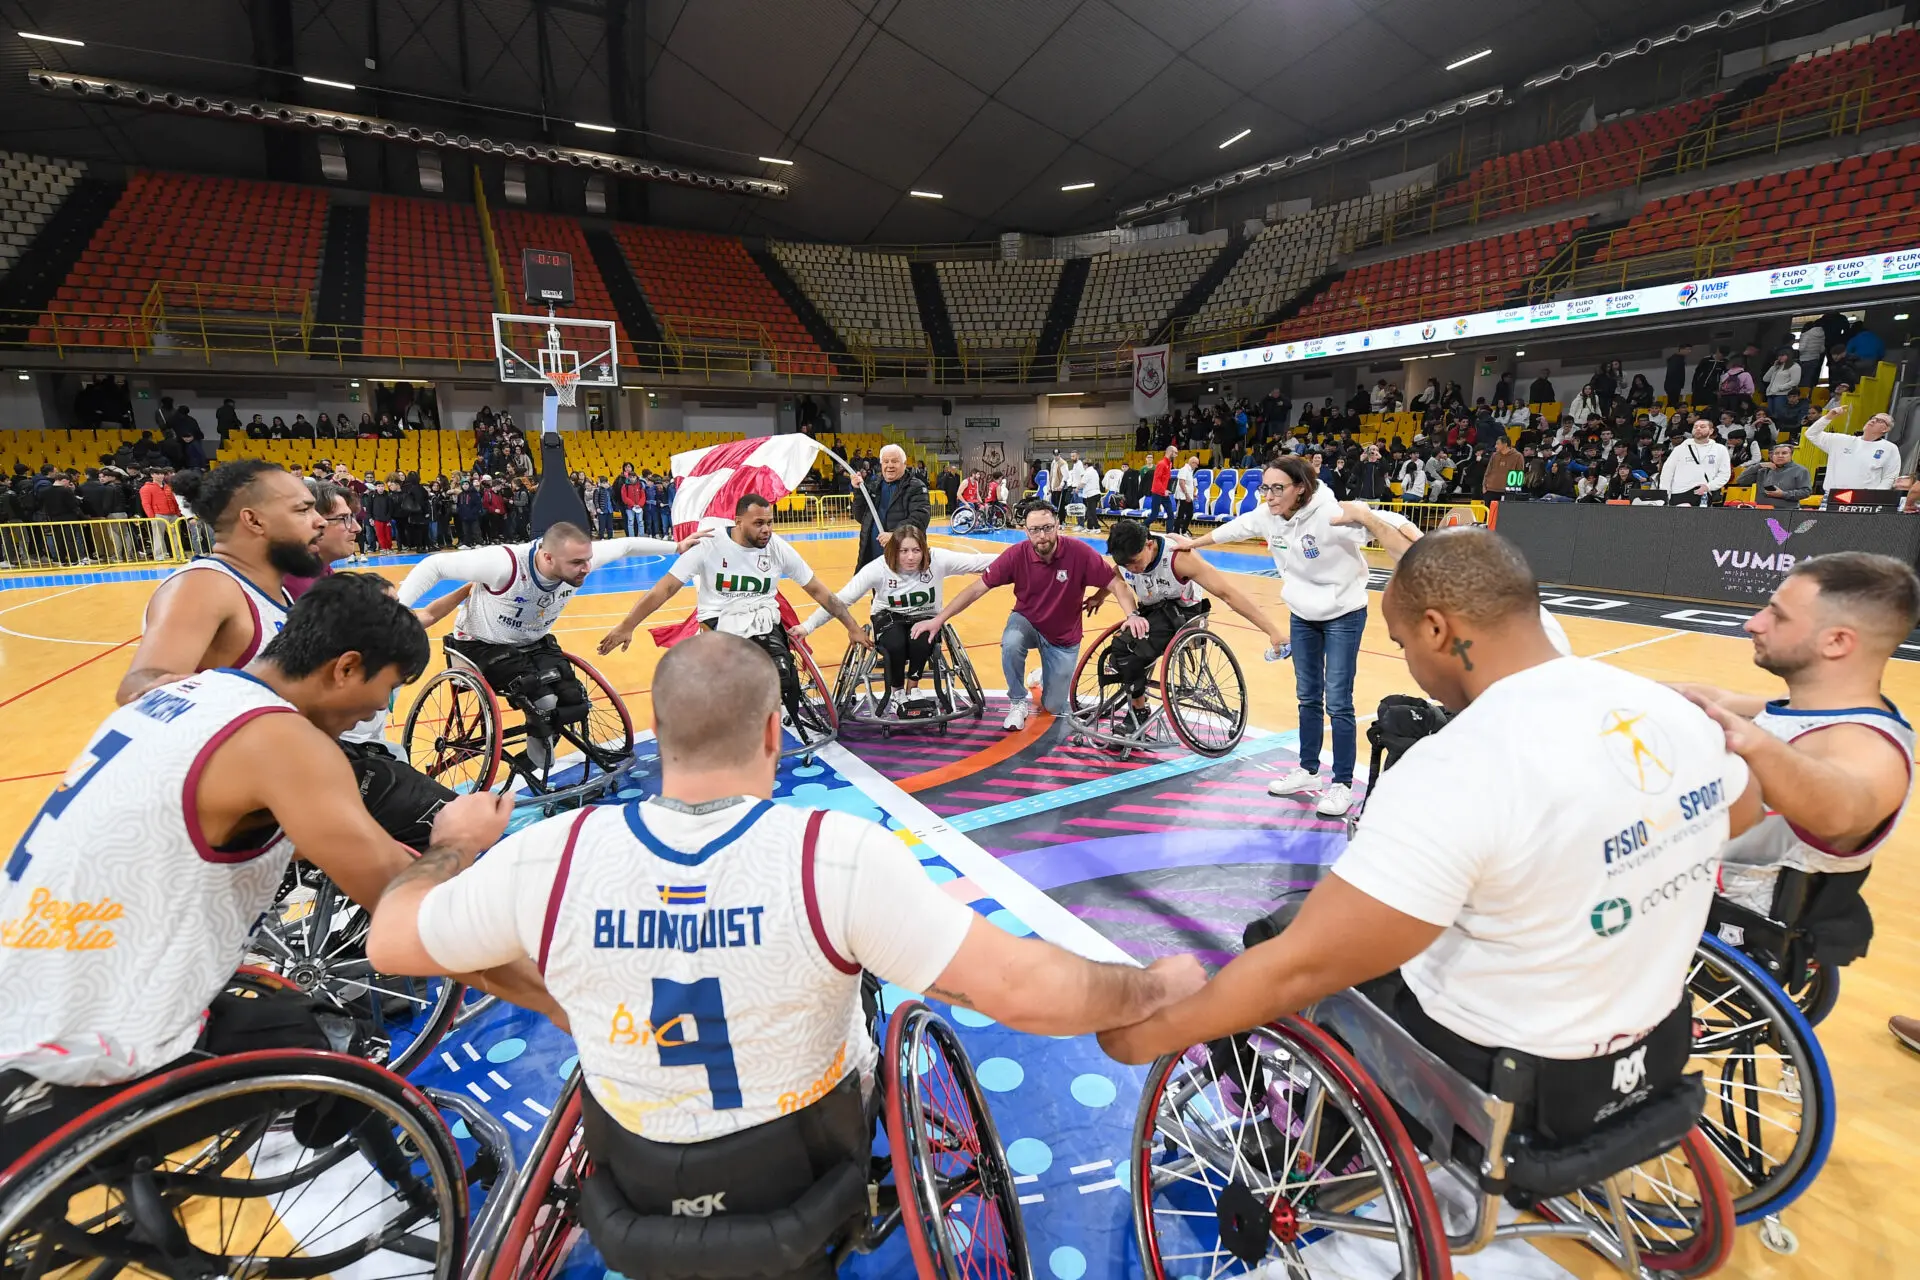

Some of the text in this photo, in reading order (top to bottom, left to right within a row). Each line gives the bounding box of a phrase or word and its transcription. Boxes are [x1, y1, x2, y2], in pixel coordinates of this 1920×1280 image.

[1836, 261, 1864, 271] EURO
[1782, 269, 1807, 278] EURO
[1838, 270, 1861, 279] CUP
[1783, 277, 1803, 286] CUP
[1702, 281, 1730, 293] IWBF
[1614, 294, 1635, 302] EURO
[1701, 291, 1729, 301] Europe
[1615, 301, 1632, 309] CUP
[1712, 549, 1812, 572] VUMB
[715, 573, 771, 594] HDI
[888, 579, 898, 588] 23
[888, 587, 936, 607] HDI
[1603, 820, 1649, 864] FISIO
[649, 976, 744, 1112] 9
[671, 1191, 728, 1218] RGK
